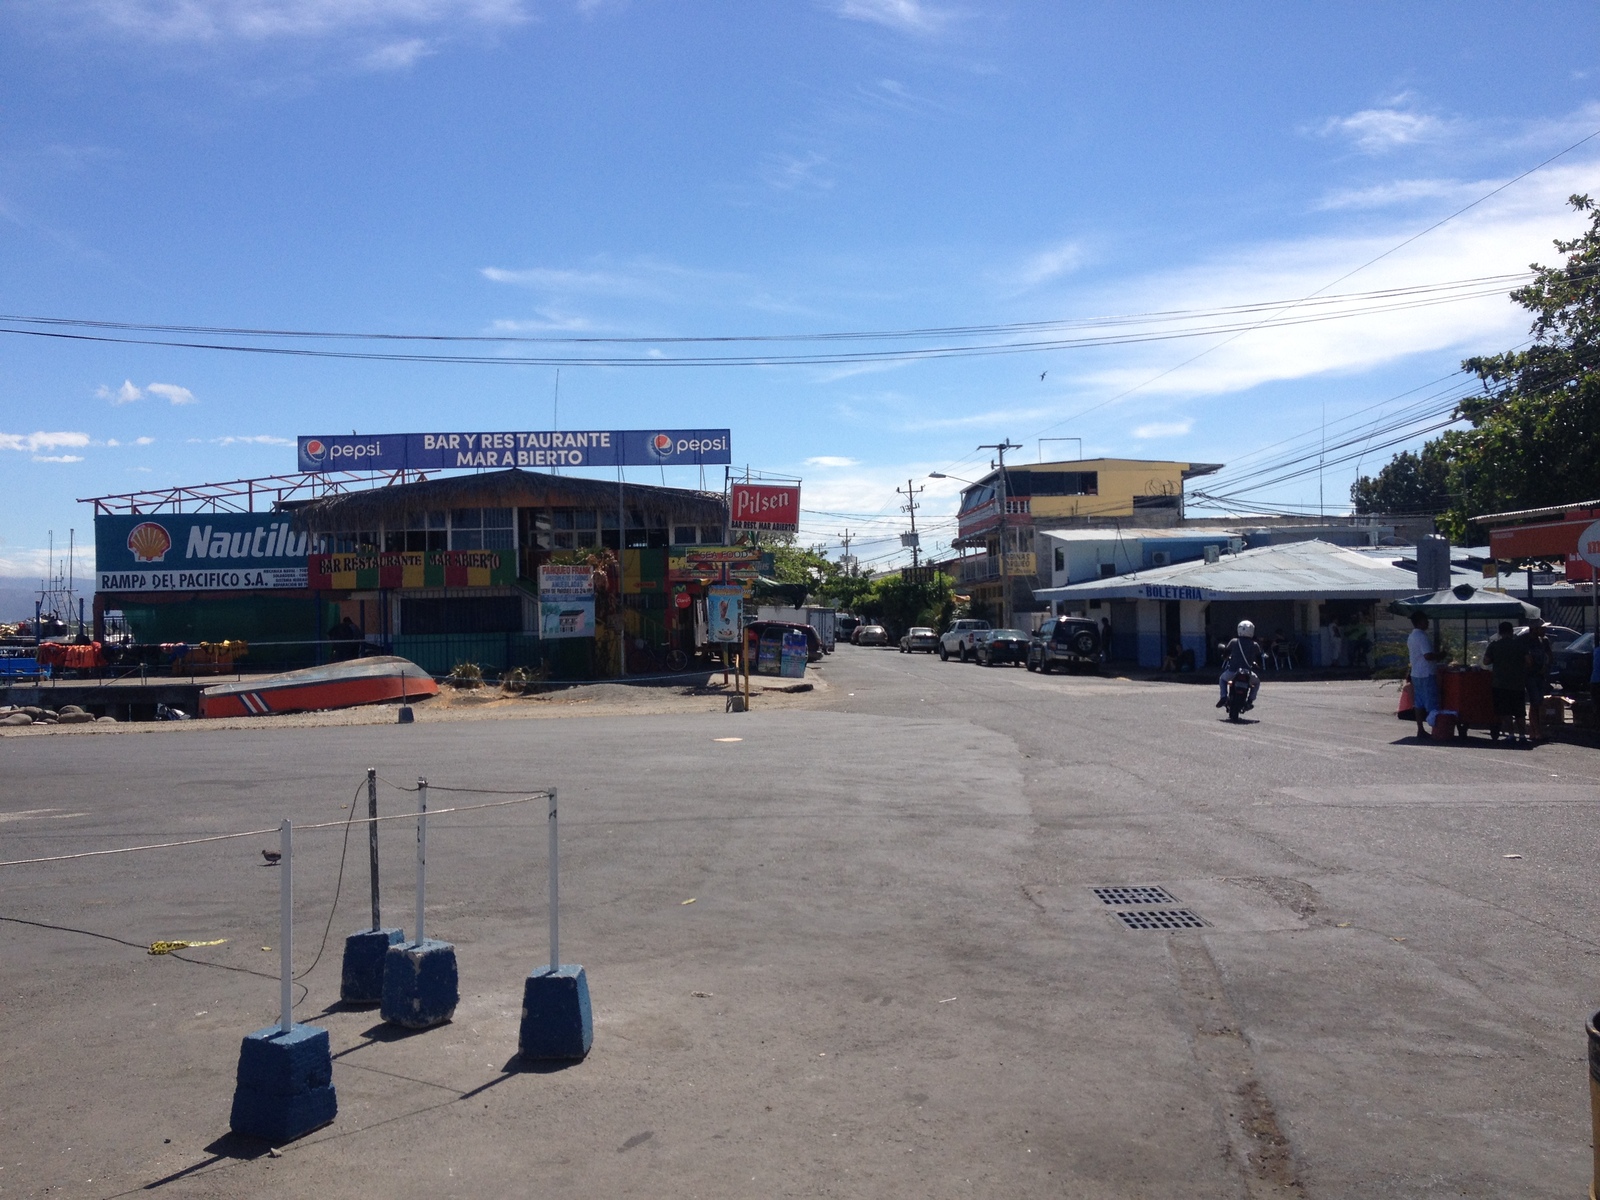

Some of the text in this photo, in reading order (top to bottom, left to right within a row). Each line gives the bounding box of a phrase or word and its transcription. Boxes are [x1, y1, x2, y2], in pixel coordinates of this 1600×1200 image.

[330, 441, 381, 459] pepsi
[424, 433, 611, 450] BAR Y RESTAURANTE
[676, 436, 727, 455] pepsi
[456, 450, 583, 467] MAR ABIERTO
[737, 490, 789, 518] Pilsen
[731, 520, 743, 529] BAR
[758, 522, 772, 530] MAR
[772, 523, 796, 531] ABIERTO
[700, 551, 748, 559] SEA FOOD
[319, 553, 501, 575] BAR RESTAURANTE MAR ABIERTO
[102, 571, 269, 589] RAMPA DEL PACIFICO S.A.
[1146, 586, 1202, 600] BOLETERIA
